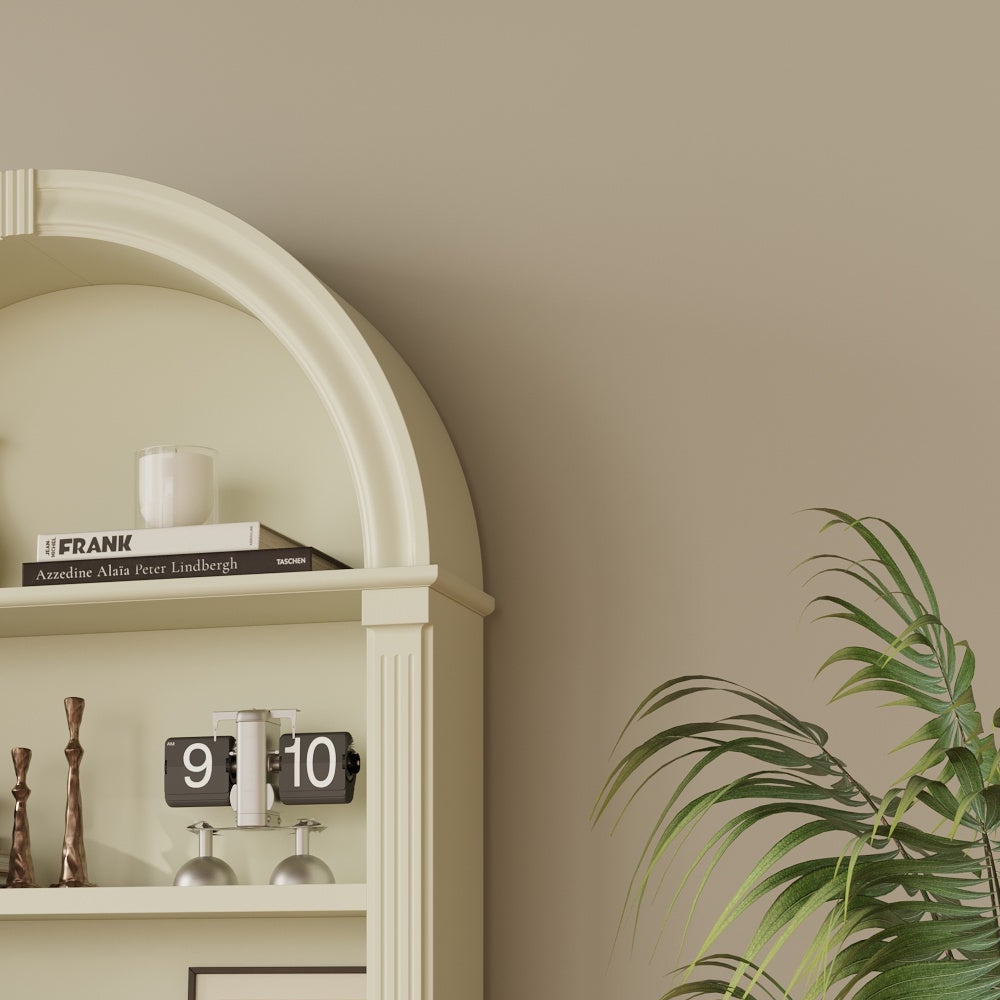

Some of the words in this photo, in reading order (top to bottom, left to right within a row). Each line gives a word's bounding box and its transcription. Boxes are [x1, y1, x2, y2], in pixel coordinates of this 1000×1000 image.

[59, 535, 133, 555] FRANK
[36, 567, 93, 581] Azzedine
[97, 564, 130, 577] Alaïa
[135, 563, 167, 575] Peter
[171, 557, 238, 574] Lindbergh
[276, 557, 307, 566] TASCHEN
[183, 742, 213, 788] 9
[284, 736, 337, 788] 10
